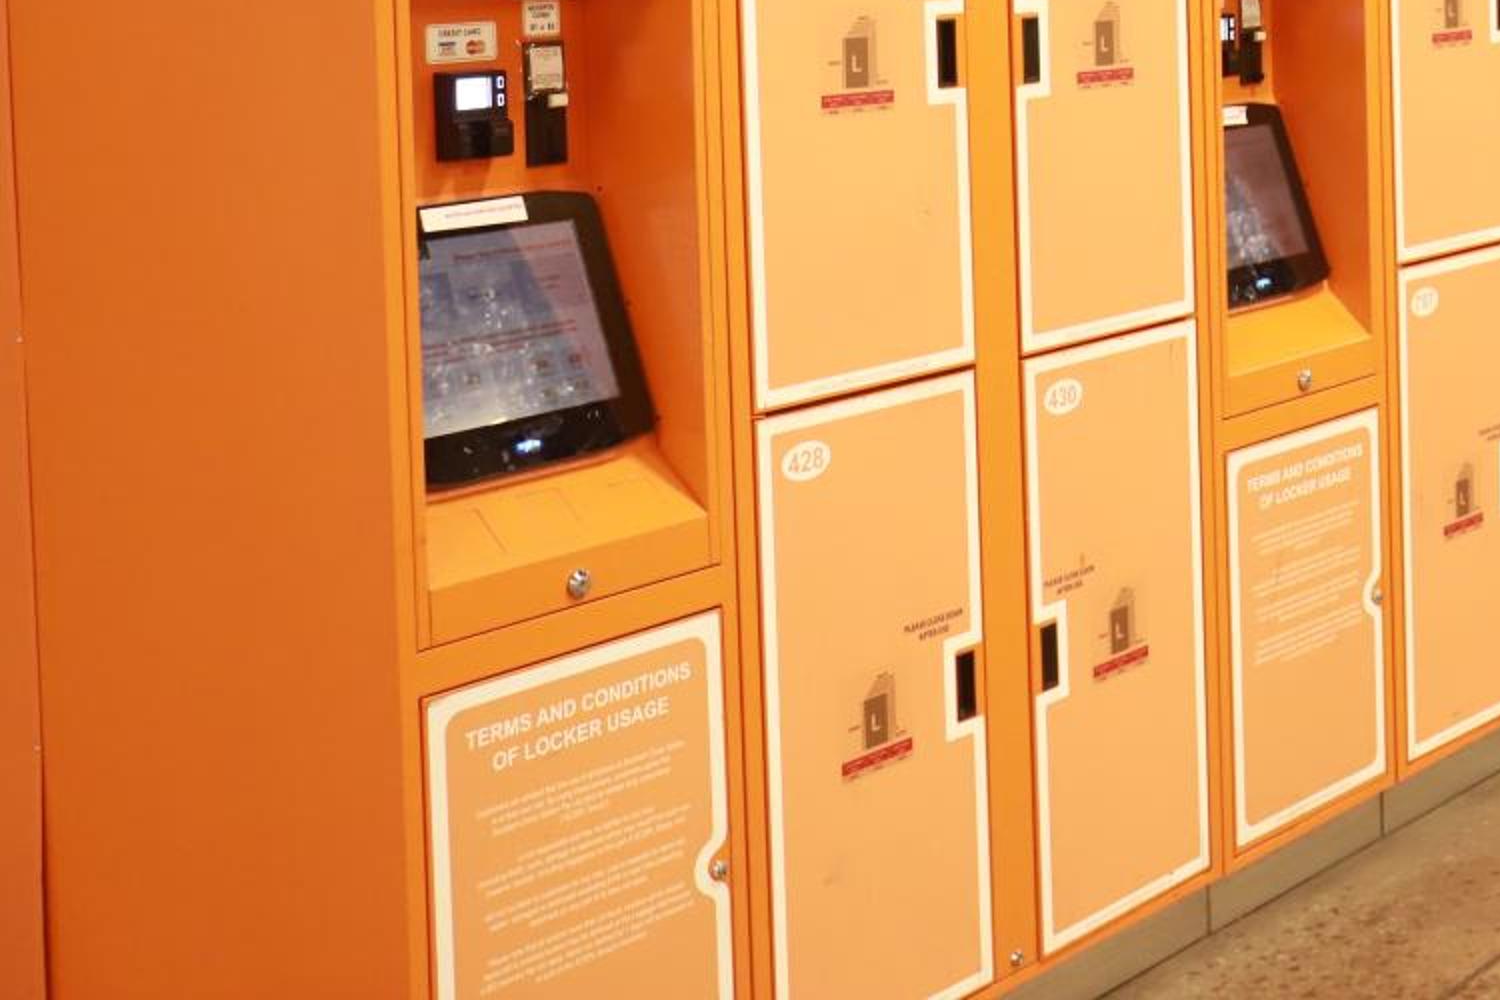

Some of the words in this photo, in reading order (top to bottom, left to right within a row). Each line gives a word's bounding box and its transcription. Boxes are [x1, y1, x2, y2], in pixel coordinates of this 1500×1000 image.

[1100, 35, 1109, 52] L
[850, 54, 863, 73] L
[1047, 382, 1078, 407] 430
[786, 446, 825, 474] 428
[465, 712, 533, 751] TERMS
[536, 698, 577, 729] AND
[581, 662, 692, 712] CONDITIONS
[491, 744, 521, 772] OF
[524, 717, 603, 761] LOCKER
[606, 695, 670, 732] USAGE
[871, 712, 881, 732] L
